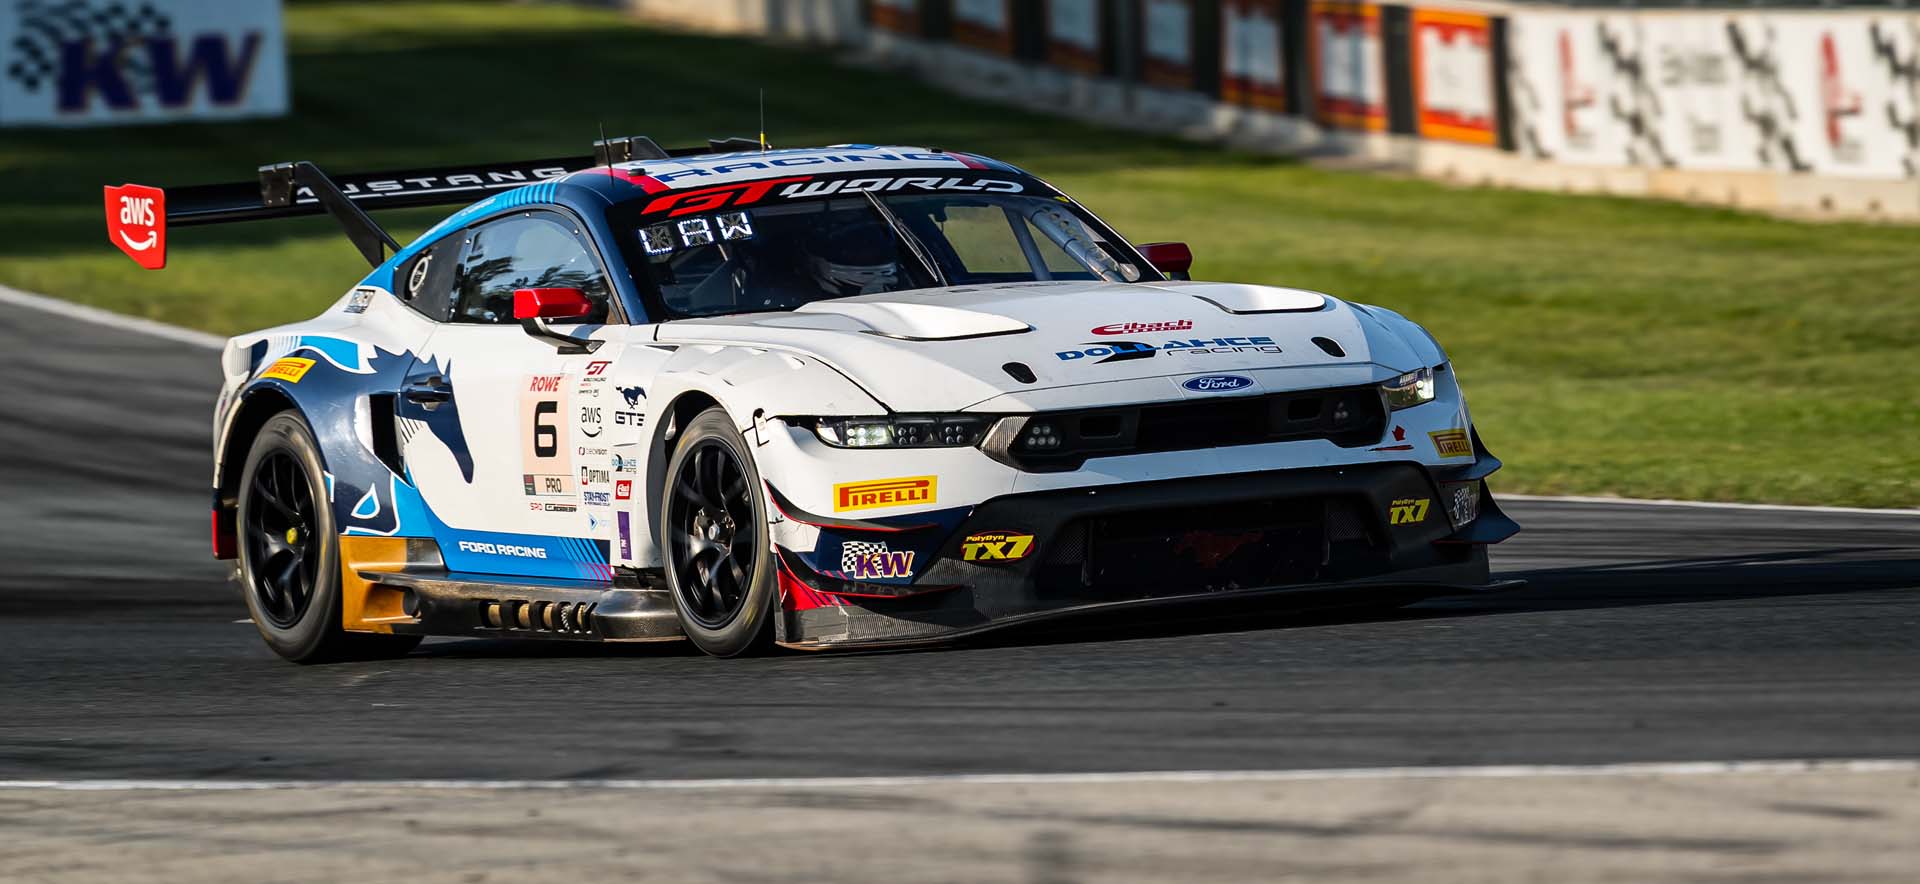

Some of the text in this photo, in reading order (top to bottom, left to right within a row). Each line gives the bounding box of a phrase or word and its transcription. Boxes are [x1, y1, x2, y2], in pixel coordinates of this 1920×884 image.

[58, 30, 262, 113] KW
[655, 152, 958, 183] RACING
[641, 176, 1024, 217] GT WORLD
[120, 196, 155, 226] aws
[639, 212, 752, 254] LAW
[1166, 345, 1283, 356] racing
[530, 376, 560, 391] ROWE
[1198, 377, 1240, 389] Ford
[581, 407, 601, 423] aws
[534, 401, 558, 457] 6
[545, 477, 562, 493] PRO
[839, 479, 930, 508] PIRELLI
[1390, 499, 1430, 525] TX7
[459, 541, 547, 559] FORD RACING
[962, 535, 1034, 561] TX7
[854, 551, 915, 579] KW
